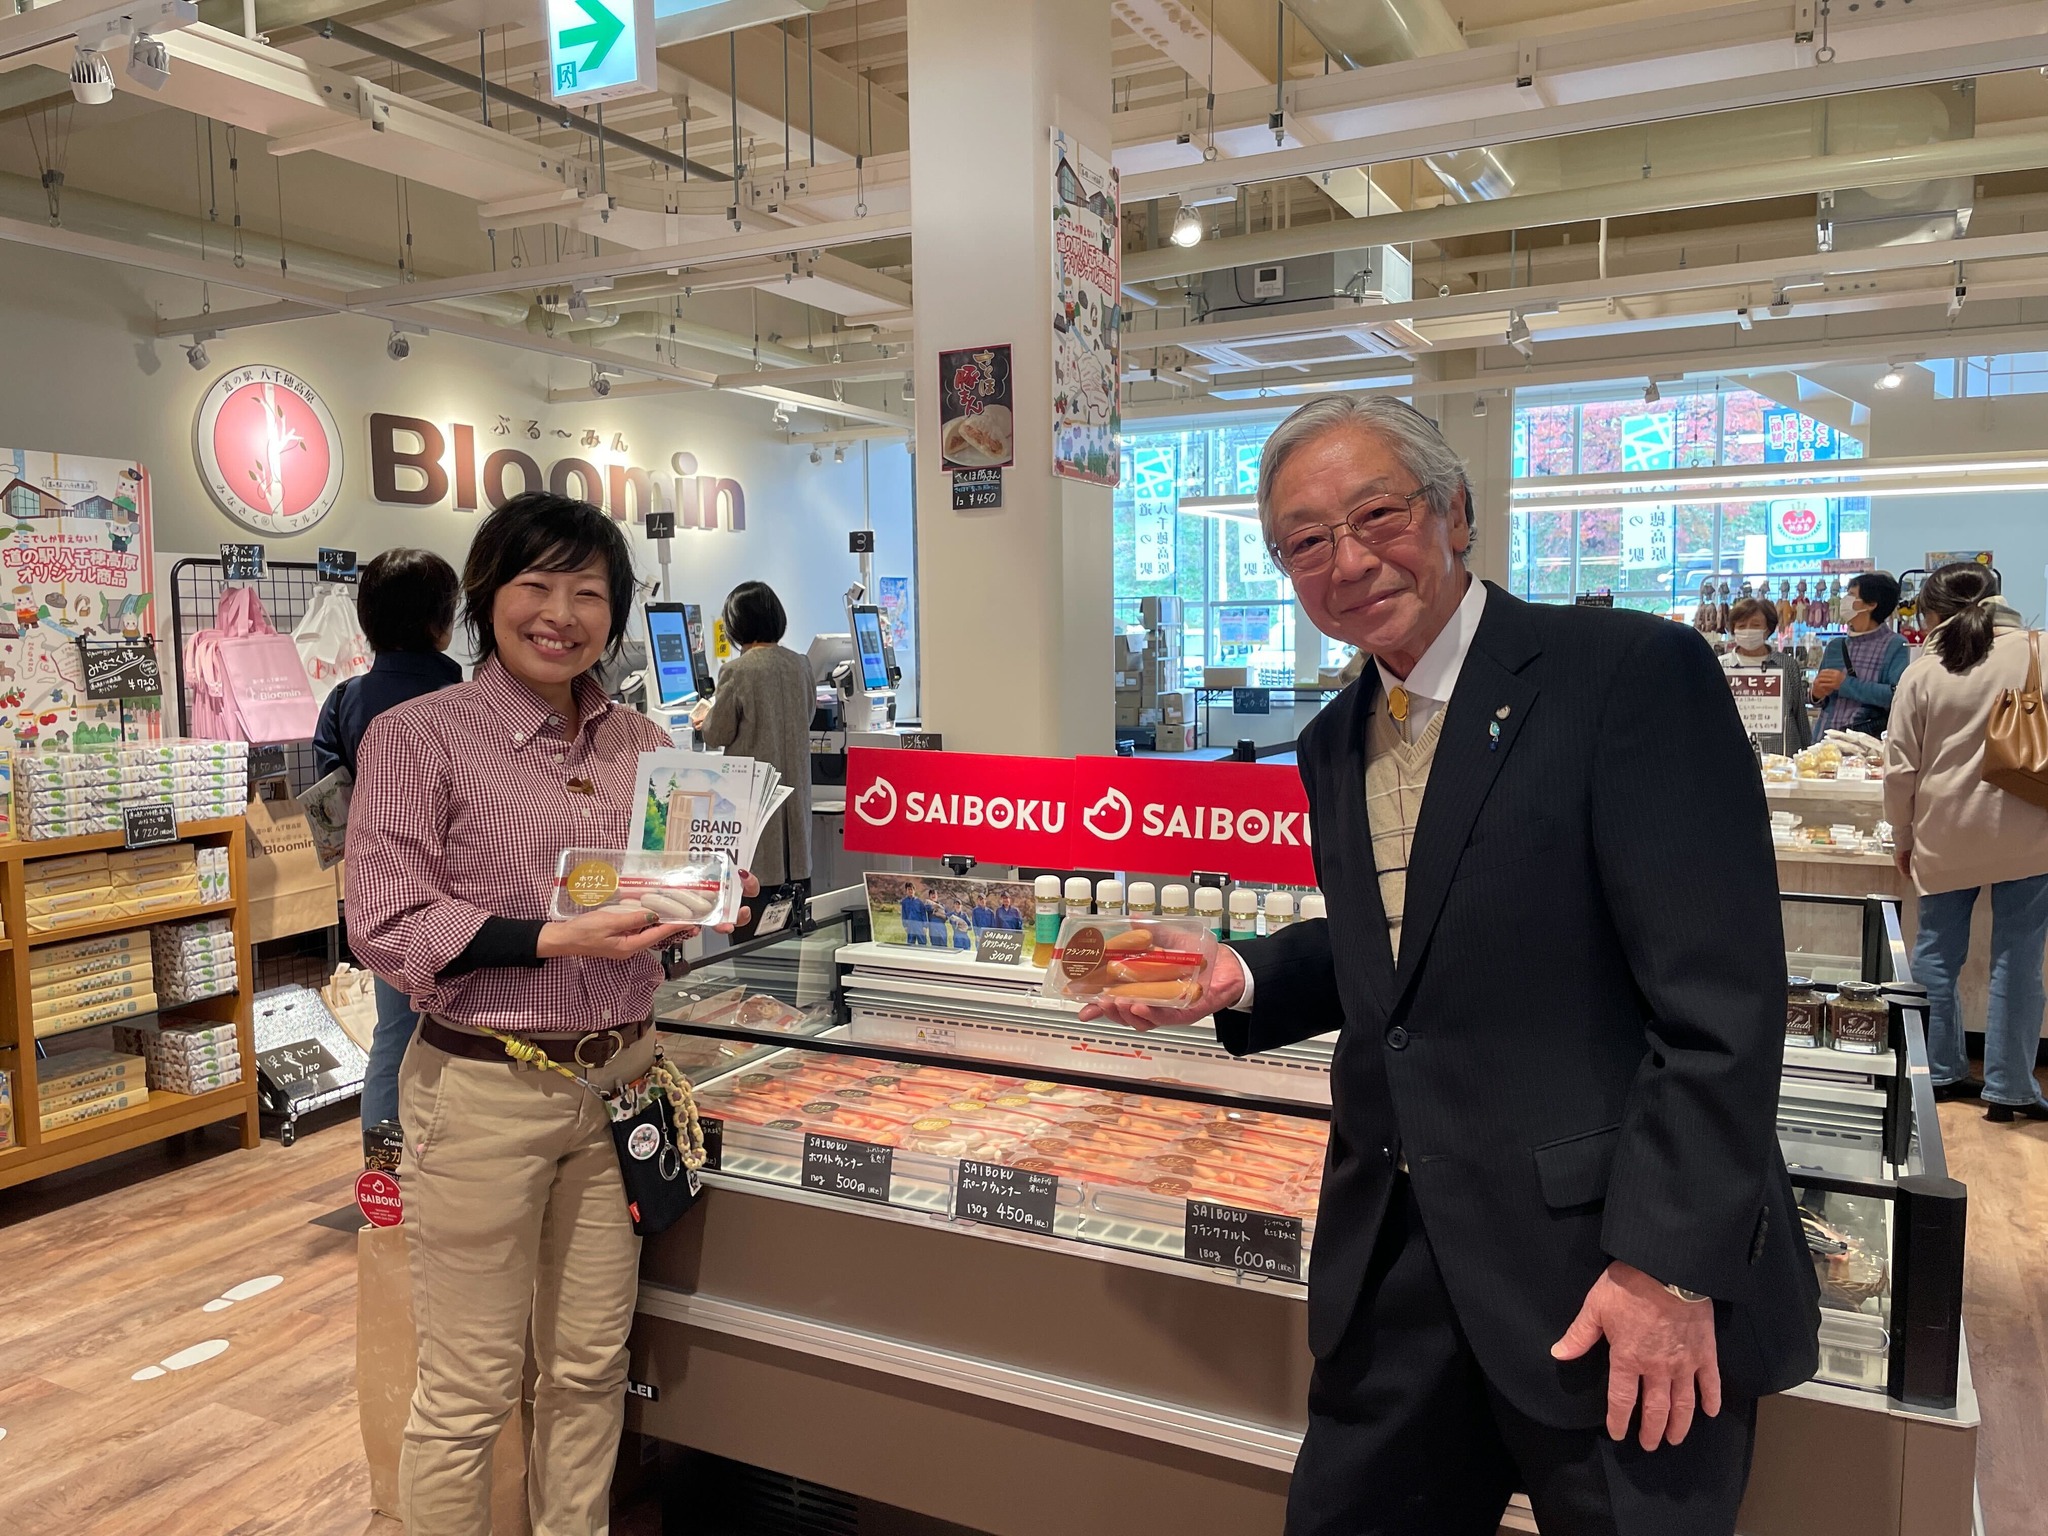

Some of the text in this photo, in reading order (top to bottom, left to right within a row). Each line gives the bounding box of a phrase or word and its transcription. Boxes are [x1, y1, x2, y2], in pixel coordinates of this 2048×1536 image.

[222, 368, 317, 404] 道の駅 八千穂高原
[953, 364, 984, 416] 豚まん
[367, 411, 746, 532] Bloomin
[652, 516, 668, 537] 4
[855, 532, 867, 552] 3
[3, 546, 139, 571] 道の駅八千穂高原
[17, 563, 128, 588] オリジナル商品
[260, 689, 302, 700] Bloomin
[905, 791, 1066, 834] SAIBOKU
[690, 819, 742, 835] GRAND
[689, 834, 736, 847] 2024.9.27
[989, 950, 1013, 962] 310円
[1066, 948, 1100, 956] フランクフルト
[810, 1137, 848, 1151] SAIBOKU
[964, 1162, 1014, 1180] SAIBOKU
[836, 1173, 865, 1193] 500円
[360, 1193, 402, 1208] SAIBOKU
[967, 1203, 988, 1218] 130g
[996, 1202, 1034, 1225] 450円
[1192, 1204, 1248, 1223] SAIBOKU
[1191, 1223, 1251, 1242] フランクフルト
[1199, 1248, 1221, 1262] 180g
[1234, 1246, 1276, 1270] 600円
